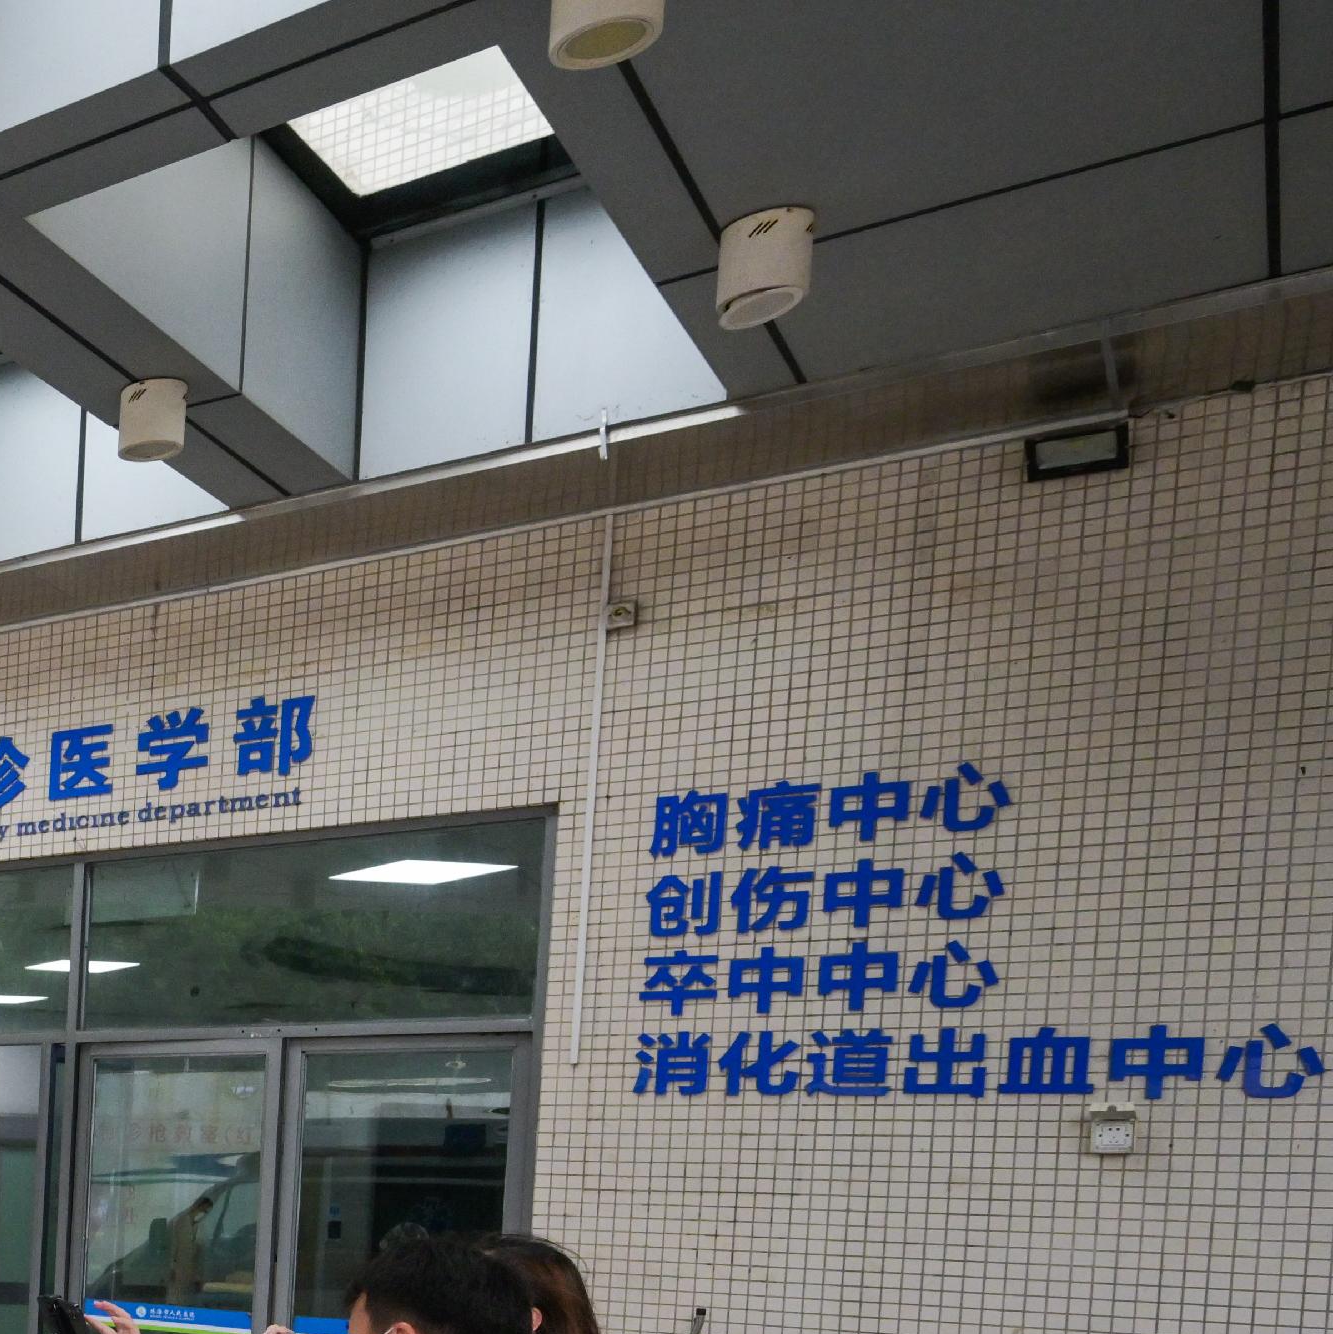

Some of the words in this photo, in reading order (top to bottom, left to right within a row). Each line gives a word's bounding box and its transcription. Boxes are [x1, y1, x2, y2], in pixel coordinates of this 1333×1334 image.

[16, 808, 130, 837] medicine
[137, 787, 302, 823] department
[649, 761, 1013, 858] 胸痛中心
[645, 851, 1006, 939] 创伤中心
[637, 940, 1001, 1017] 卒中中心
[632, 1022, 1327, 1100] 消化道出血中心
